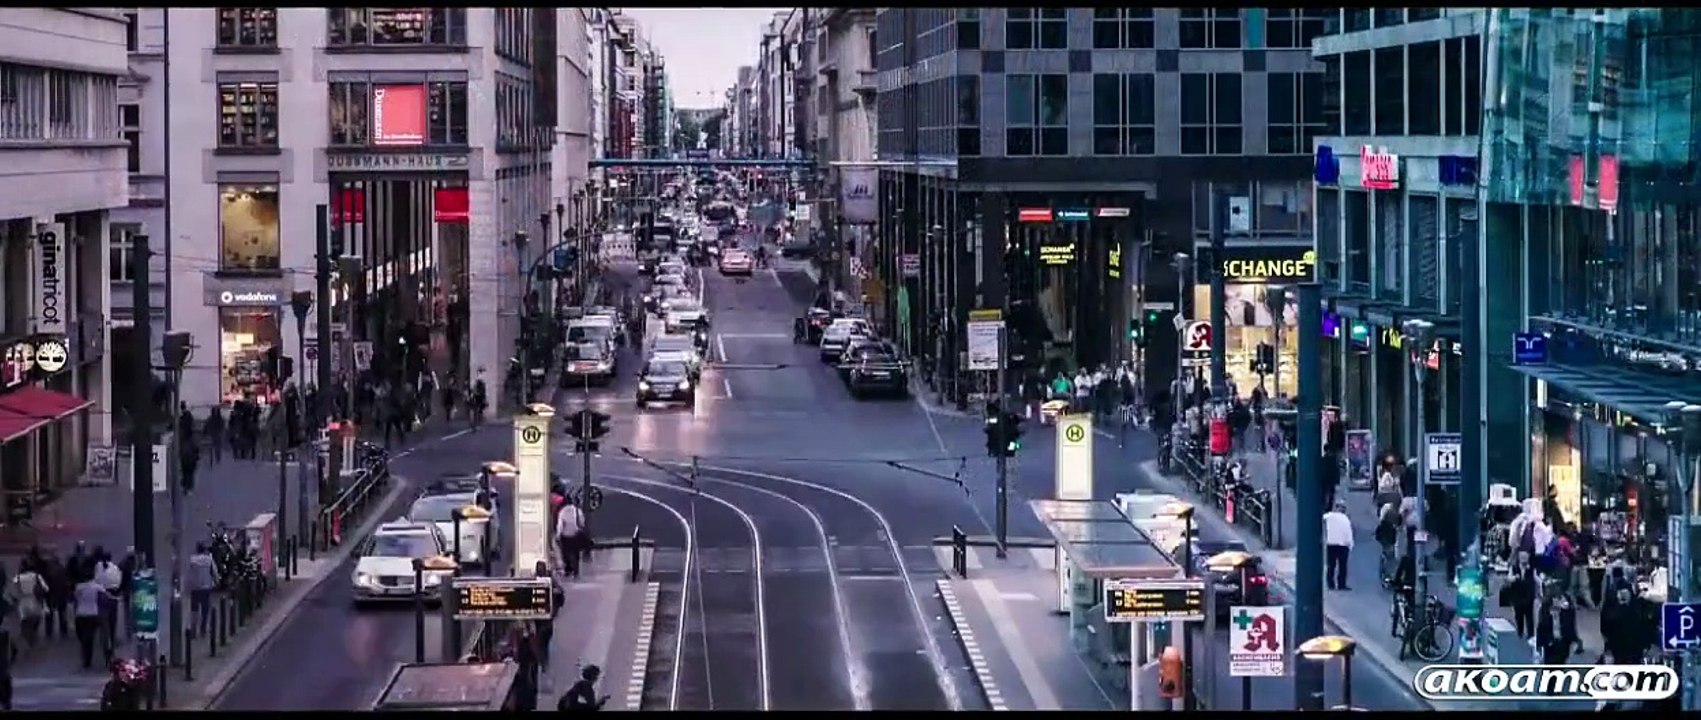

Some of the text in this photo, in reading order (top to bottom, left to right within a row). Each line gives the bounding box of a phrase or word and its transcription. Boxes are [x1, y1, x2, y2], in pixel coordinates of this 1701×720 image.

[38, 231, 61, 325] ginatricot
[235, 292, 277, 302] vodafone
[1680, 615, 1694, 639] P
